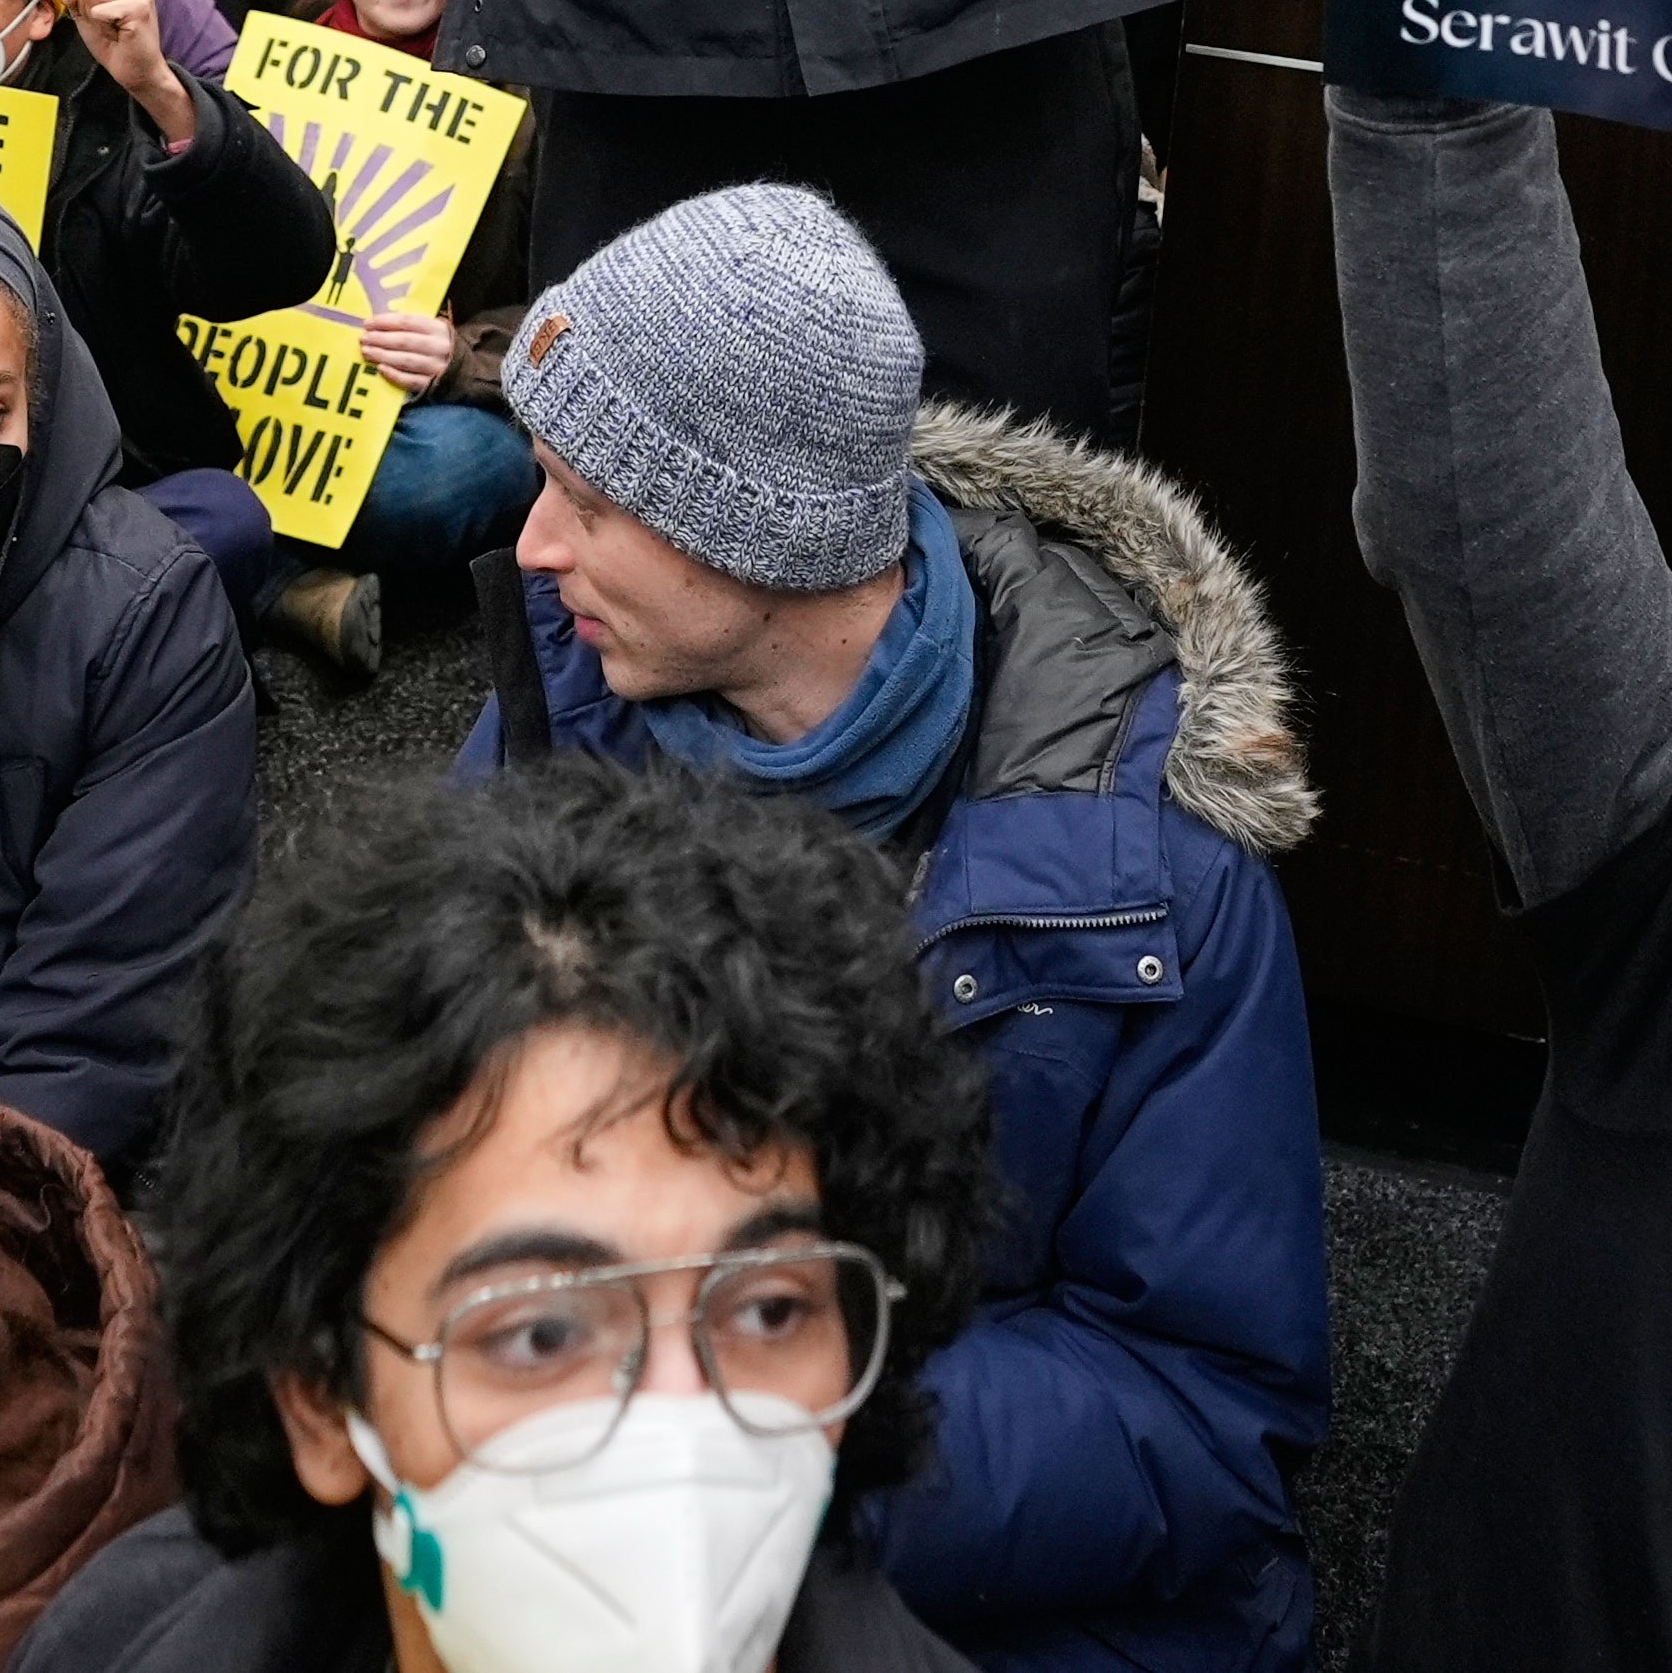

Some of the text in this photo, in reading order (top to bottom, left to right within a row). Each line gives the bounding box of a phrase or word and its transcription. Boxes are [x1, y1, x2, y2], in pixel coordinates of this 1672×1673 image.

[254, 37, 485, 145] FOR THE
[229, 407, 353, 505] OVE
